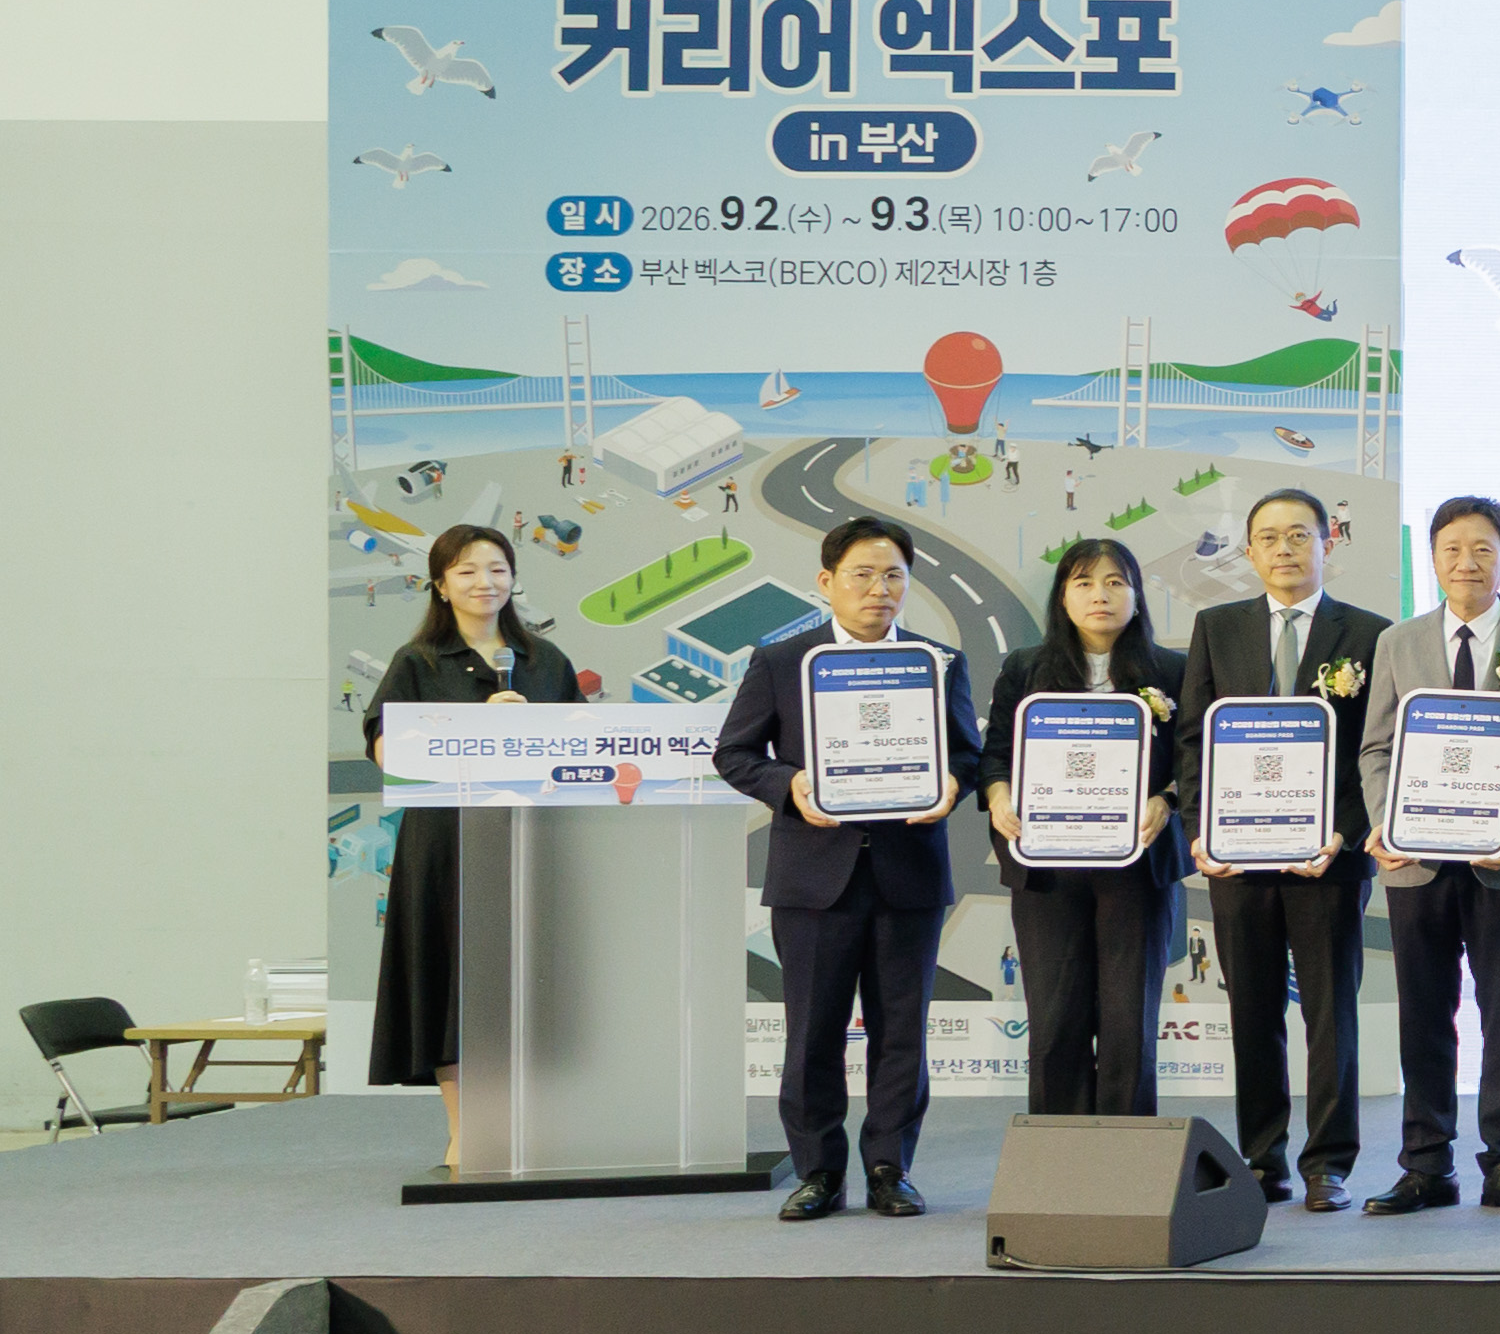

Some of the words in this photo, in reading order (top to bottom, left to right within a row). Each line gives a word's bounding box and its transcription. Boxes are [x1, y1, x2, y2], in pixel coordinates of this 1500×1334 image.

[808, 123, 847, 163] in
[857, 121, 940, 166] 부산
[993, 205, 1179, 235] 10:00~17:00
[639, 256, 690, 288] 부산
[694, 256, 889, 290] 벡스코(BEXCO)
[894, 256, 1011, 288] 제2전시장
[1019, 256, 1058, 288] 1층
[603, 726, 652, 734] CAREER
[428, 738, 495, 756] 2026
[502, 737, 588, 757] 항공산업
[595, 737, 661, 756] 커리어
[668, 737, 720, 756] 엑스
[825, 740, 849, 748] JOB
[873, 736, 928, 747] SUCCESS
[561, 768, 576, 781] in
[578, 768, 605, 781] 부산
[1030, 786, 1053, 795] JOB
[1076, 787, 1129, 795] SUCCESS
[1406, 779, 1428, 788] JOB
[1450, 781, 1500, 791] SUCCESS
[1220, 790, 1242, 798] JOB
[1264, 789, 1316, 798] SUCCESS
[1158, 1021, 1199, 1040] AC
